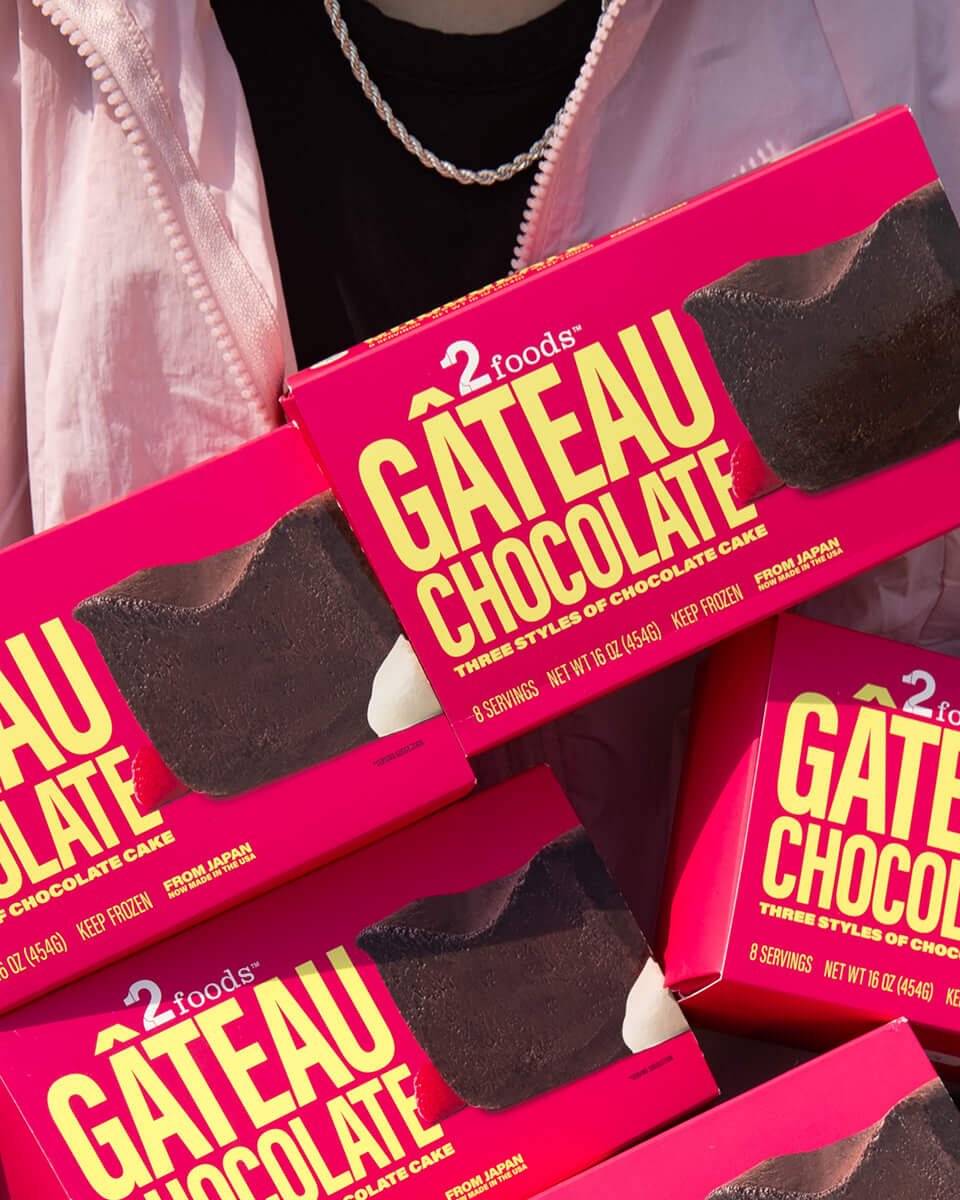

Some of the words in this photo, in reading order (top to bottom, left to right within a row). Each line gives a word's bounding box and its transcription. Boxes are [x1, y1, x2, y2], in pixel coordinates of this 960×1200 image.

[357, 308, 715, 572] GÂTEAU
[415, 438, 758, 657] CHOCOLATE
[753, 557, 795, 585] FROM
[796, 536, 839, 565] JAPAN
[452, 642, 514, 677] THREE
[513, 610, 582, 650] STYLES
[583, 597, 608, 617] OF
[609, 547, 717, 605] CHOCOLATE
[717, 523, 768, 555] CAKE
[472, 705, 484, 723] 8
[482, 679, 539, 718] SERVINGS
[546, 663, 571, 688] NET
[568, 653, 591, 677] WT
[589, 648, 606, 667] 16
[605, 639, 623, 661] OZ
[621, 621, 662, 655] (454G)
[670, 603, 698, 630] KEEP
[699, 583, 743, 616] FROZEN
[0, 617, 112, 793] AU
[8, 854, 123, 916] CHOCOLATE
[122, 829, 175, 862] CAKE
[162, 864, 206, 893] FROM
[206, 841, 252, 872] JAPAN
[0, 961, 9, 981] 6
[6, 952, 26, 974] OZ
[23, 931, 67, 967] (454G)
[75, 912, 105, 941] KEEP
[106, 891, 153, 926] FROZEN
[758, 901, 816, 926] THREE
[817, 916, 882, 941] STYLES
[884, 932, 909, 946] OF
[749, 942, 758, 960] 8
[759, 945, 813, 973] SERVINGS
[824, 959, 846, 980] NET
[848, 965, 867, 985] WT
[868, 969, 880, 988] 16
[881, 973, 896, 992] OZ
[897, 975, 934, 1002] (454G)
[407, 1142, 455, 1174] CAKE
[484, 1152, 524, 1181] JAPAN
